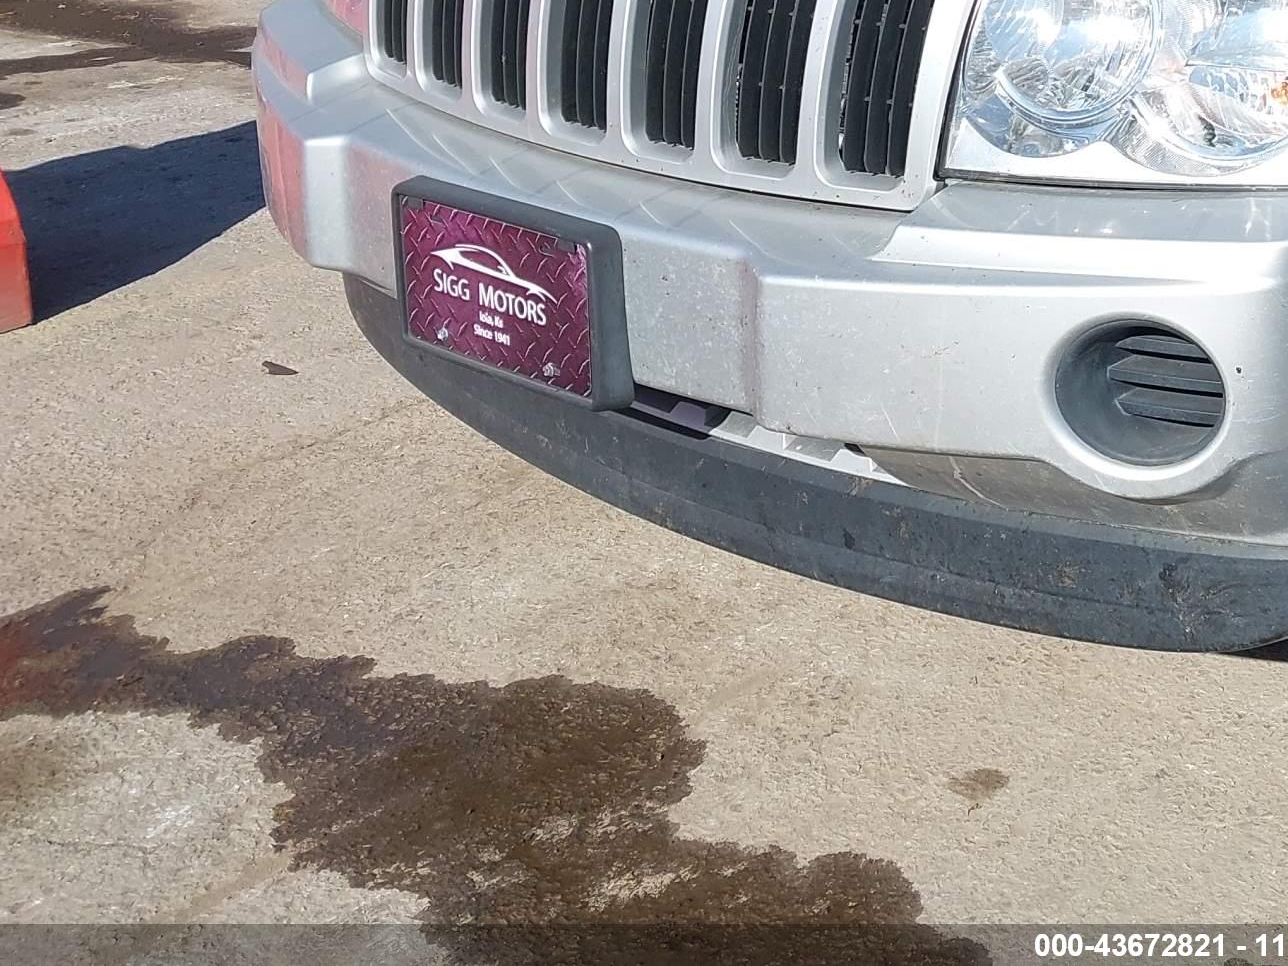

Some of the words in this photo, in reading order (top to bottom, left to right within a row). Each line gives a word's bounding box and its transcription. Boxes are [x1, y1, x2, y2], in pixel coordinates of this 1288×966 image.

[433, 268, 470, 301] SIGG
[478, 282, 546, 326] MOTORS
[473, 323, 493, 340] Since
